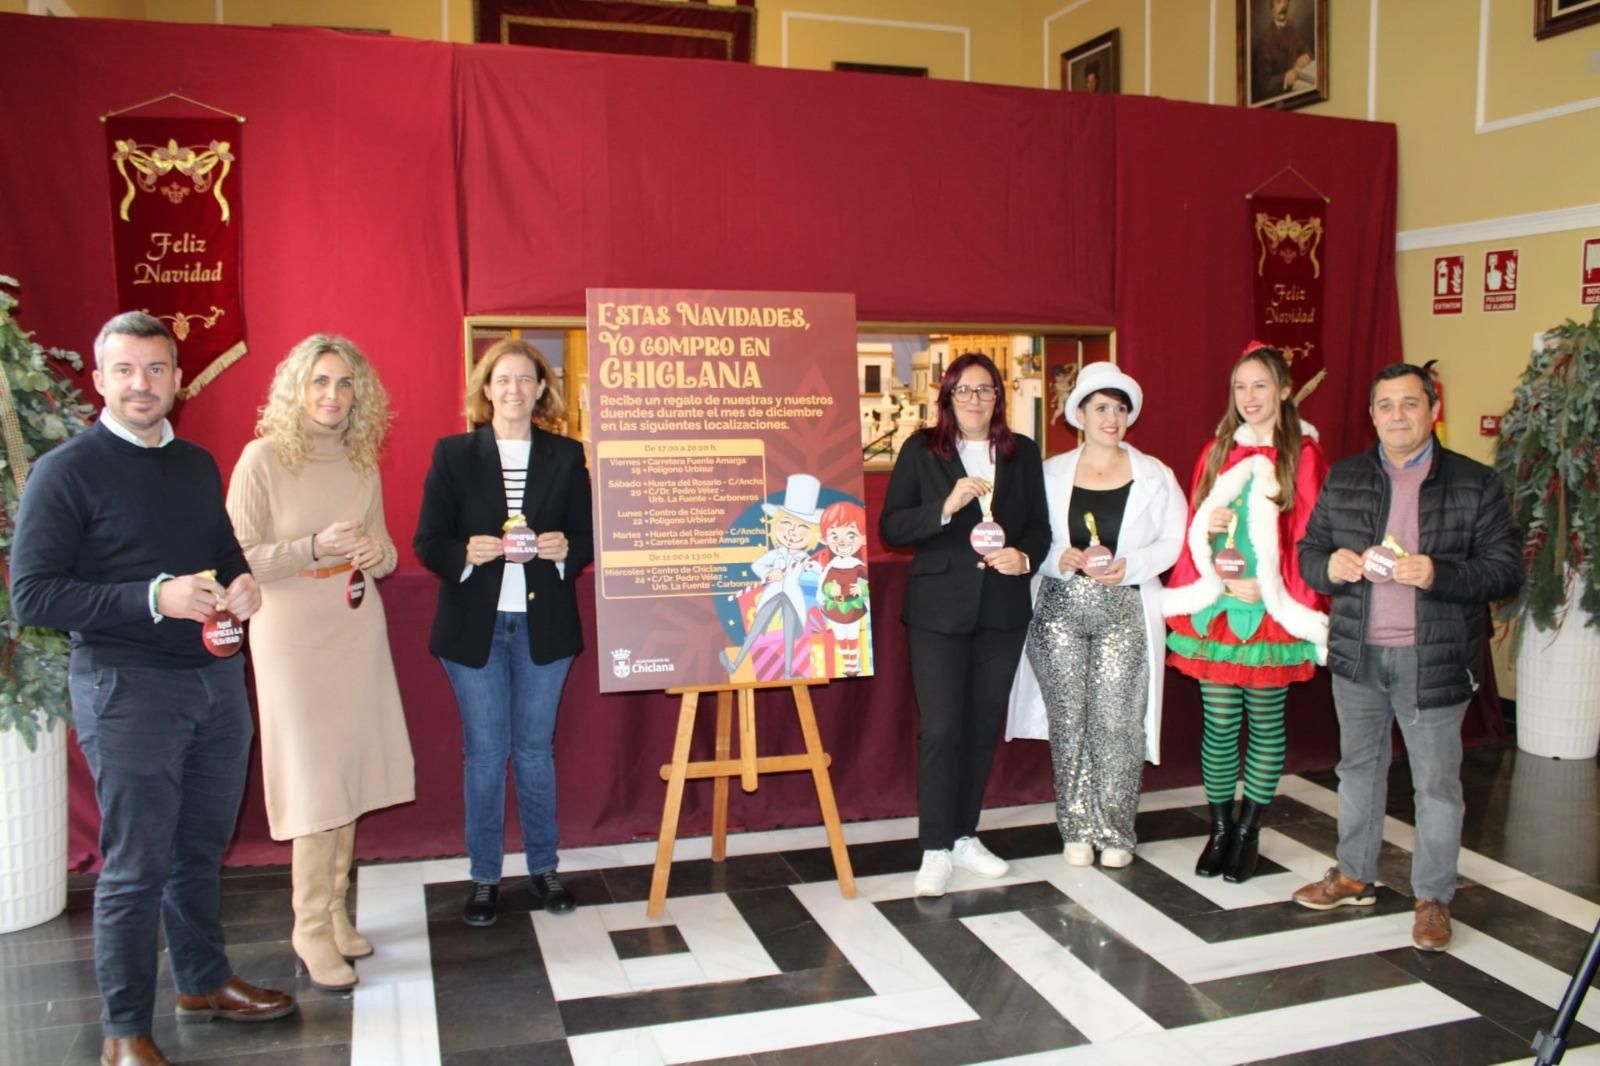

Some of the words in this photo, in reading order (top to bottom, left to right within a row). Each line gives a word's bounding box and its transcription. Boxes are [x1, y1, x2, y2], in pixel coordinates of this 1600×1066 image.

[147, 232, 206, 261] Feliz
[133, 262, 223, 284] Navidad
[1271, 283, 1306, 306] Feliz
[597, 303, 671, 331] ESTAS
[676, 301, 811, 331] NAVIDADES,
[1265, 307, 1315, 324] Navidad
[598, 331, 635, 356] YO
[640, 336, 735, 357] COMPRO
[740, 336, 771, 357] EN
[599, 357, 763, 390] CHICLANA
[600, 394, 643, 407] Recibe
[644, 396, 661, 406] un
[663, 394, 701, 408] regalo
[704, 394, 720, 406] de
[722, 395, 774, 406] nuestras
[774, 396, 783, 408] y
[784, 395, 834, 405] nuestros
[600, 408, 655, 419] duendes
[656, 407, 705, 418] durante
[706, 407, 719, 418] el
[720, 407, 746, 418] mes
[747, 406, 764, 418] de
[765, 406, 824, 418] diciembre
[600, 422, 617, 432] en
[620, 420, 638, 432] las
[639, 420, 702, 434] siguientes
[704, 418, 790, 431] localizaciones.
[609, 458, 641, 467] Viernes
[647, 458, 686, 466] Carretera
[686, 457, 715, 465] Fuente
[715, 457, 747, 466] Amarga
[631, 467, 641, 475] 19
[608, 480, 641, 488] Sábado
[648, 479, 677, 487] Huerta
[677, 478, 692, 487] del
[692, 478, 722, 486] Rosario
[728, 477, 764, 486] C/Ancha
[648, 487, 671, 496] C/Dr.
[672, 486, 697, 495] Pedro
[648, 495, 666, 503] Urb.
[667, 495, 678, 503] La
[679, 493, 707, 502] Fuente
[712, 493, 759, 502] Carboneros
[617, 509, 643, 518] Lunes
[649, 507, 677, 517] Centro
[678, 507, 690, 516] de
[690, 506, 726, 516] Chiclana
[612, 530, 641, 539] Martes
[649, 529, 679, 538] Huerta
[679, 528, 694, 537] del
[694, 527, 724, 537] Rosario
[730, 526, 766, 535] C/Ancha
[633, 540, 644, 548] 23
[650, 537, 690, 546] Carretera
[690, 535, 718, 545] Fuente
[718, 535, 750, 545] Amarga
[605, 567, 645, 576] Miércoles
[651, 565, 680, 575] Centro
[680, 565, 692, 574] de
[692, 564, 728, 573] Chiclana
[652, 575, 674, 583] C/Dr.
[675, 574, 700, 582] Pedro
[652, 583, 670, 591] Urb.
[670, 583, 682, 591] La
[682, 580, 711, 589] Fuente
[632, 663, 675, 673] Chiclana
